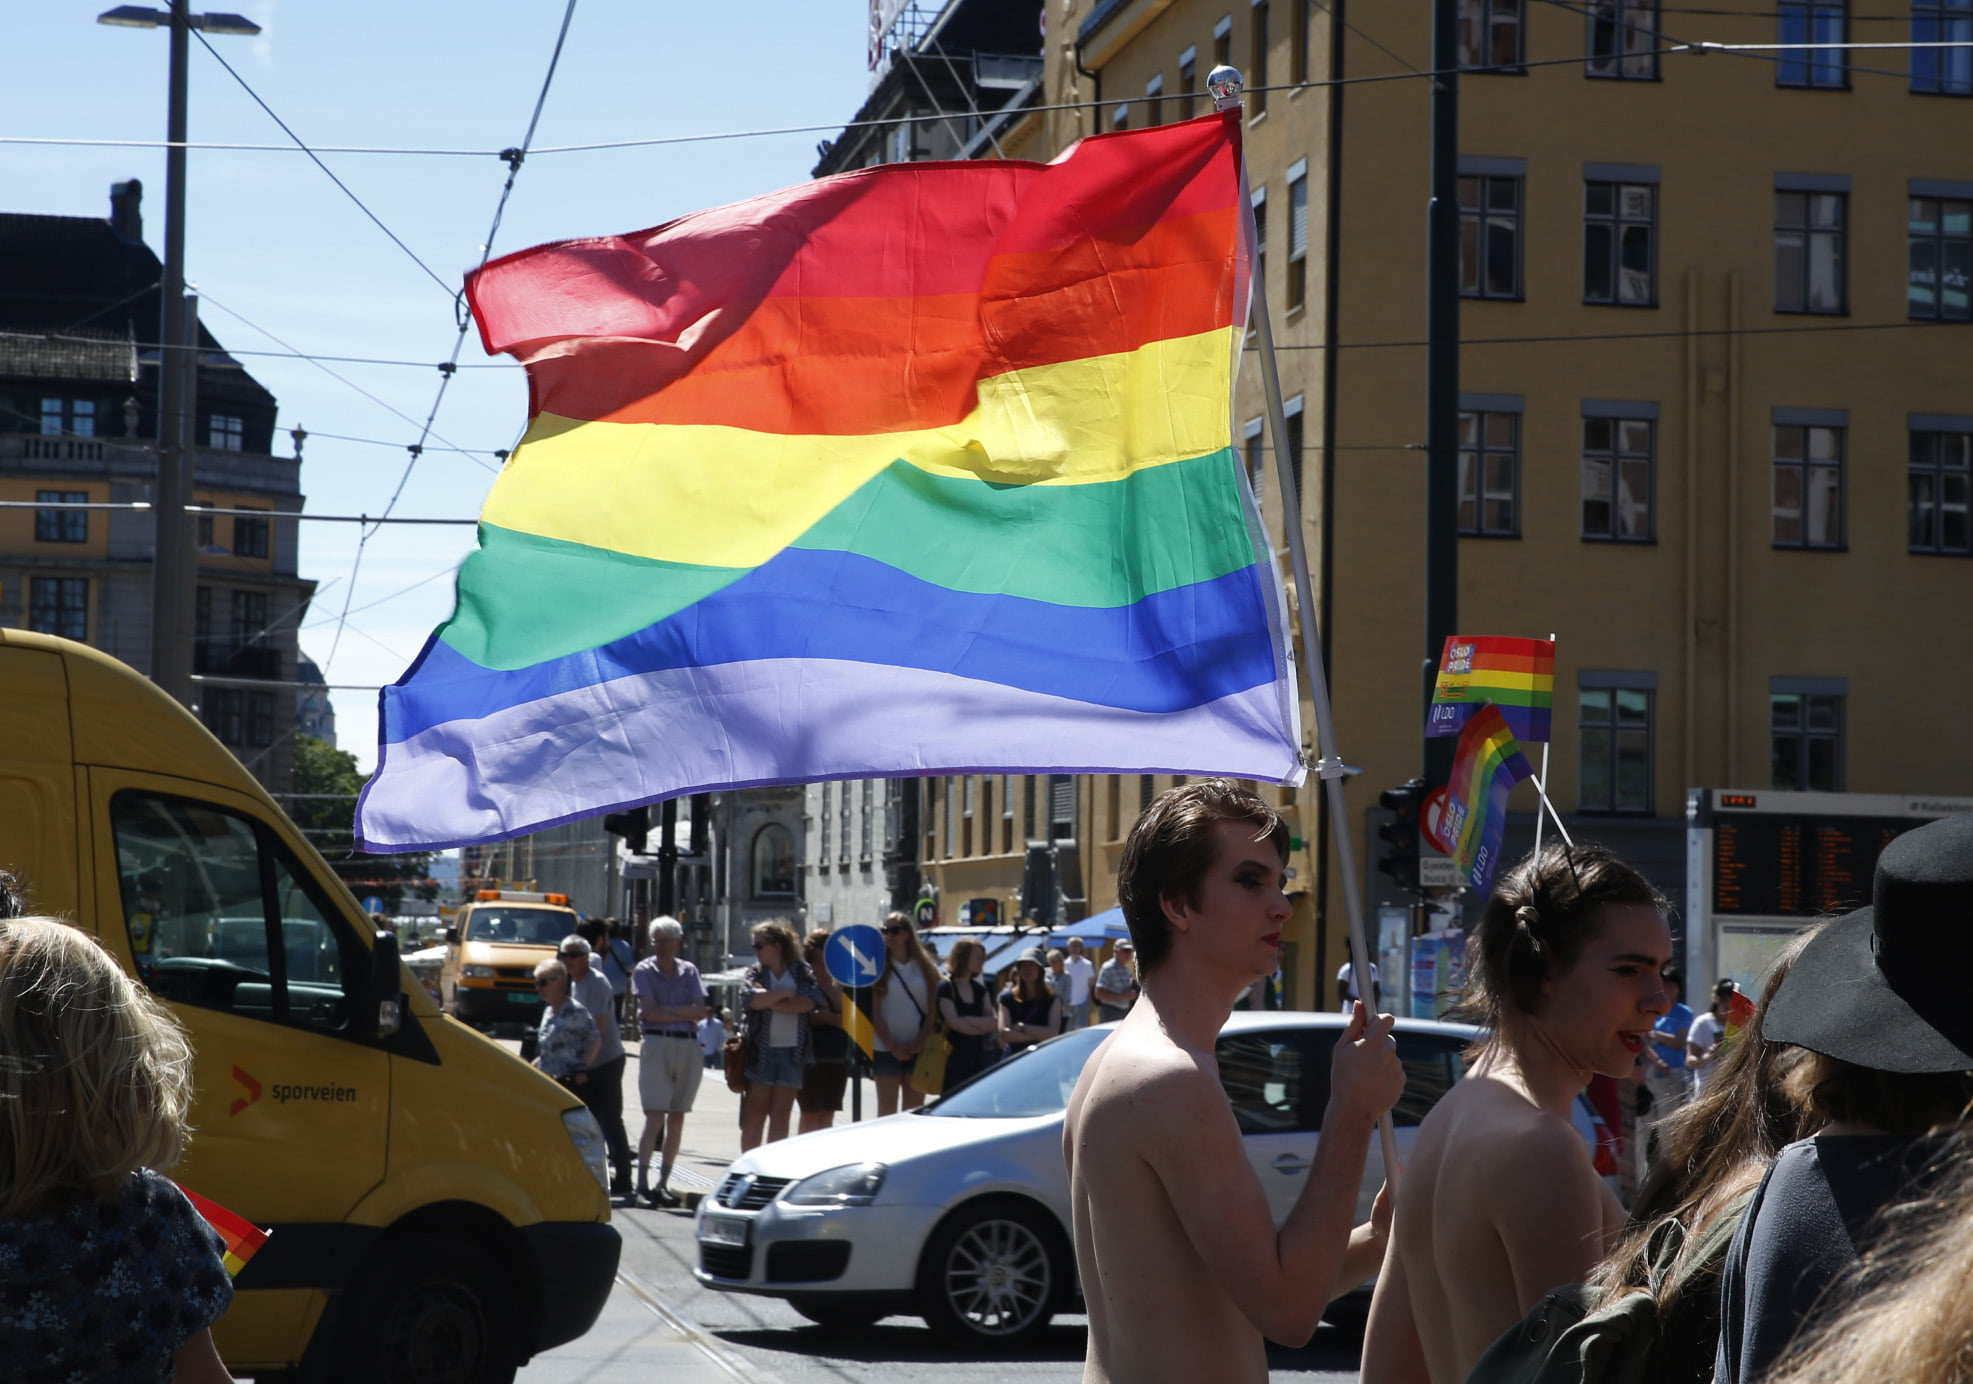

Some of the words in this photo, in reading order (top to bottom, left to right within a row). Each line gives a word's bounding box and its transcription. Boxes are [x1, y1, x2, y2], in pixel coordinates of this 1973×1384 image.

[1450, 646, 1470, 659] OSLO
[1448, 659, 1471, 672] PRIDE
[1443, 803, 1456, 838] OSLO
[1450, 805, 1465, 846] PRIDE
[272, 1082, 357, 1104] sporveien
